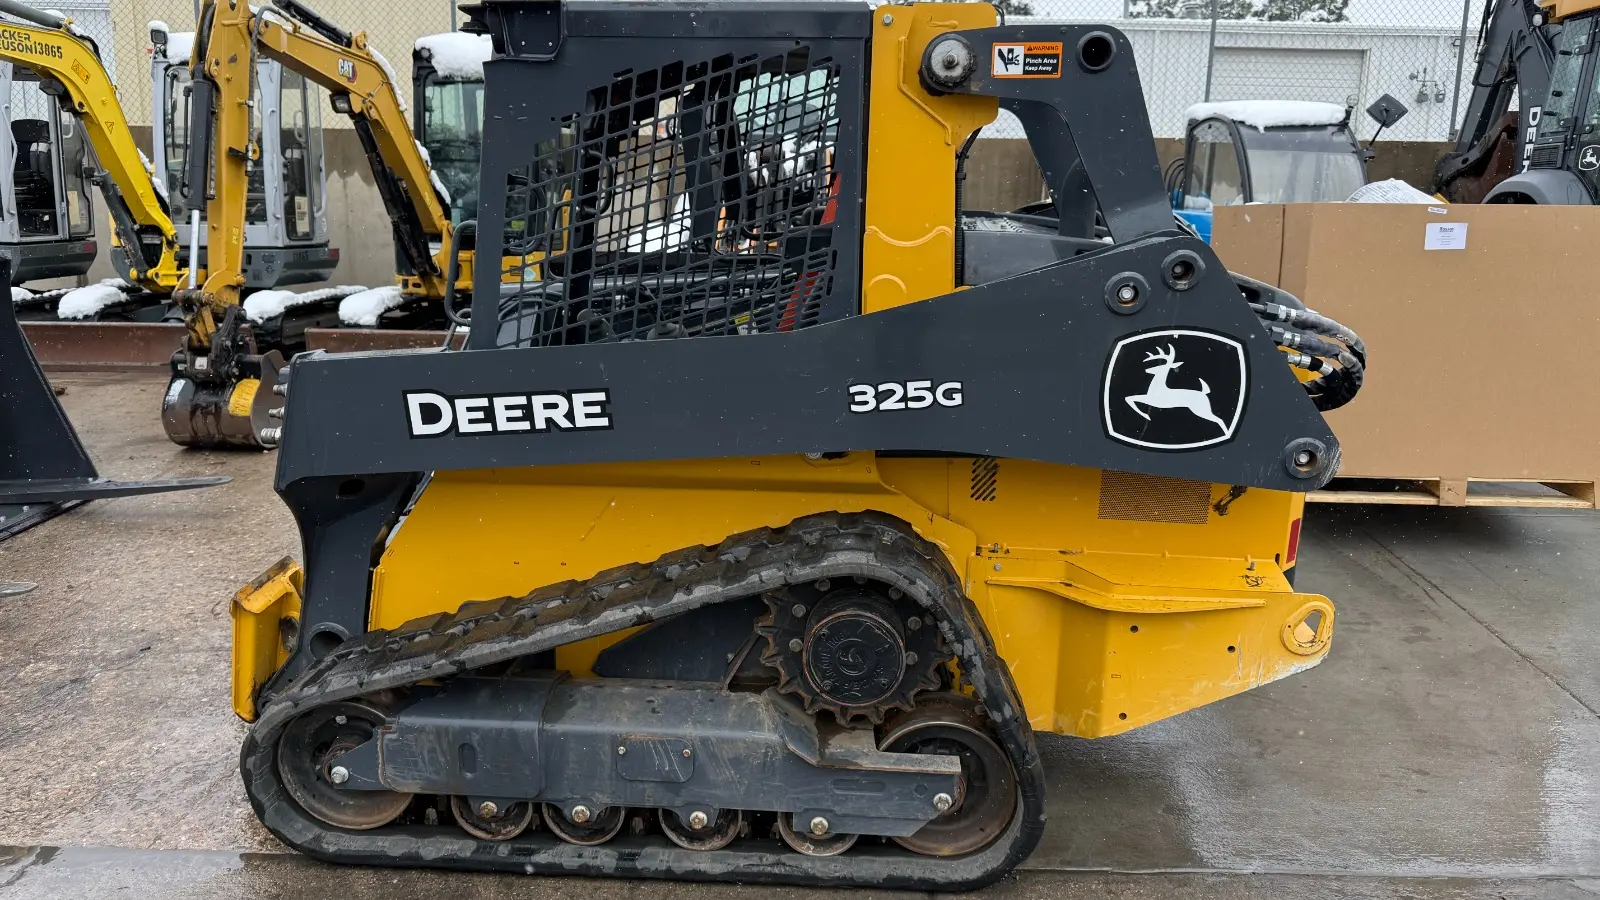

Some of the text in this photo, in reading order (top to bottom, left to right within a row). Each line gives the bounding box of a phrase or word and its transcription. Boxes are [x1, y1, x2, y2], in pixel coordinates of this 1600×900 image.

[0, 40, 34, 55] USON
[338, 58, 353, 78] CAT
[849, 380, 963, 413] 325G
[406, 391, 610, 436] DEERE
